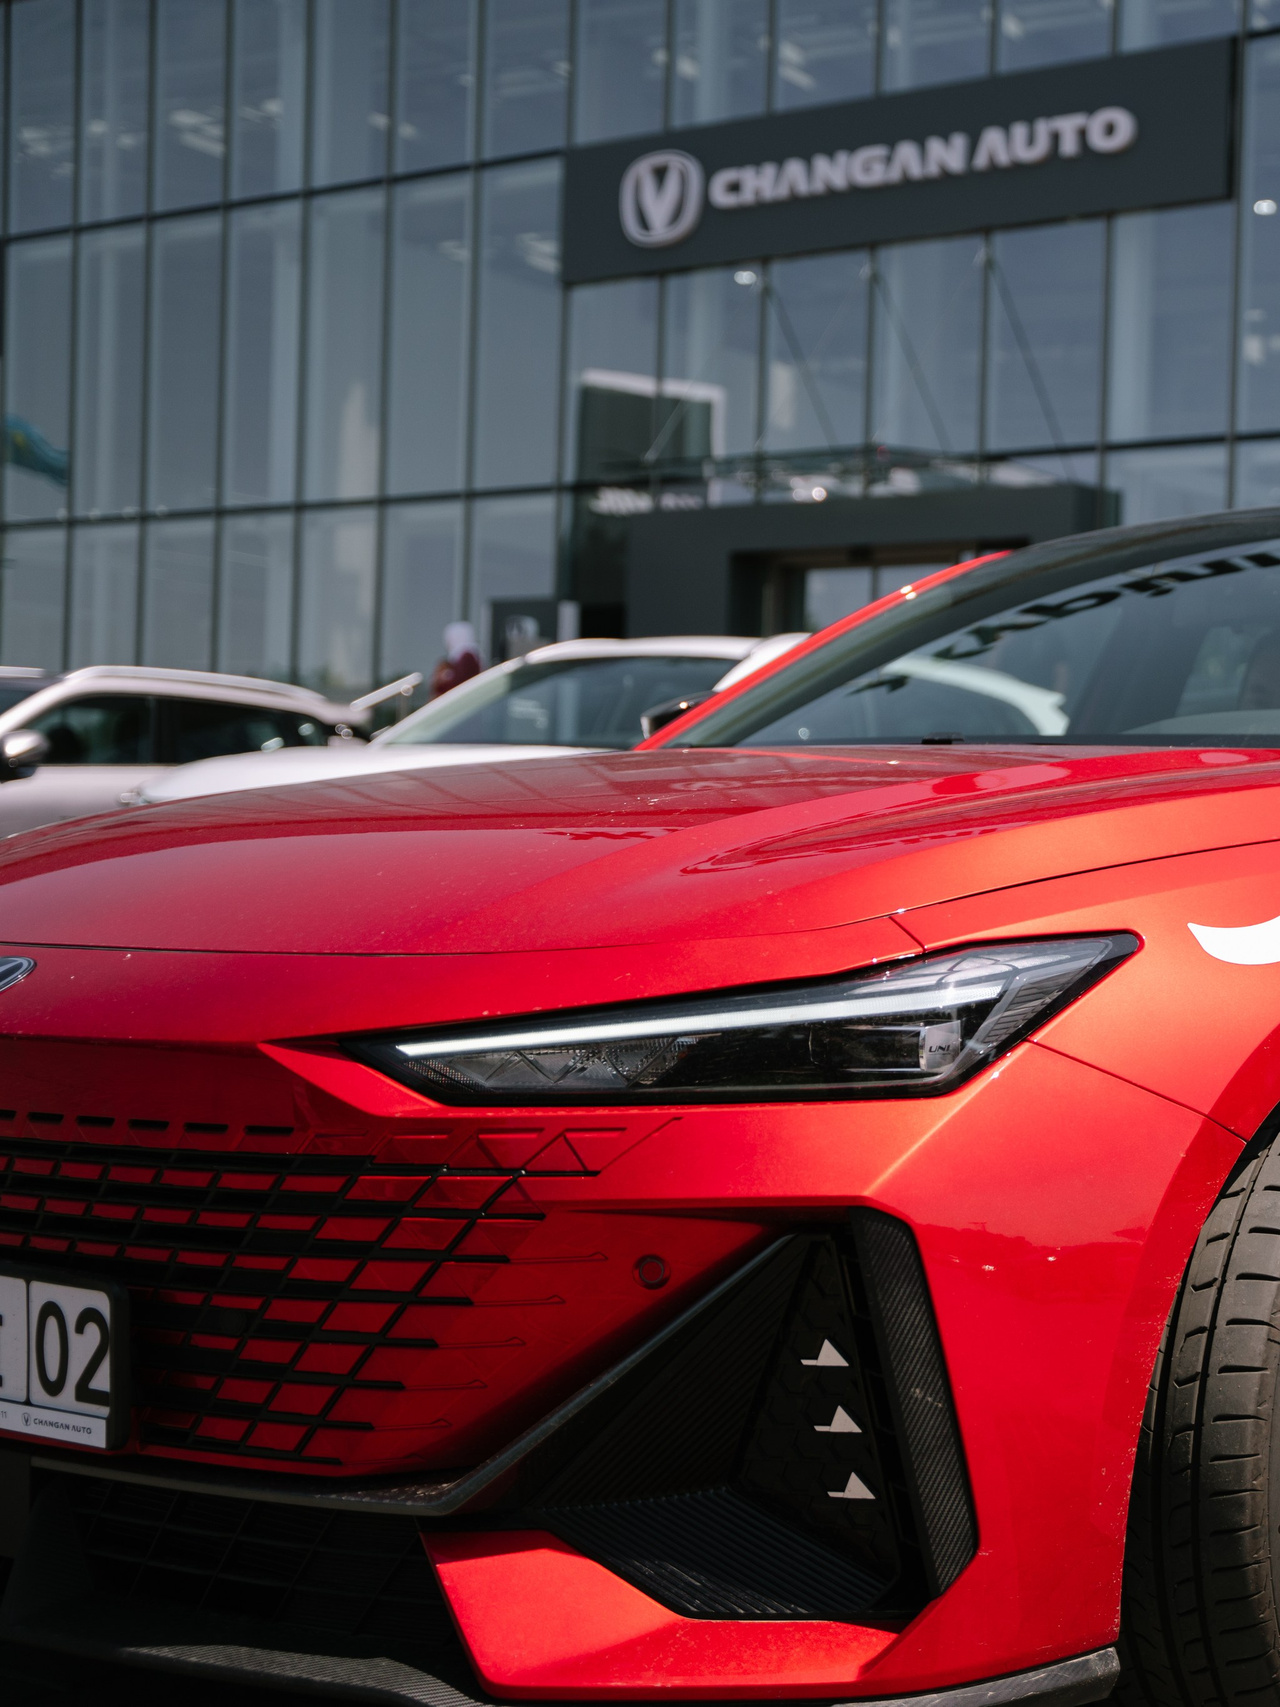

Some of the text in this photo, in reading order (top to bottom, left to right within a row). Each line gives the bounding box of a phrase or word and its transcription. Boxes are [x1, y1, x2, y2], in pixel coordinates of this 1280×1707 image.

[708, 106, 1136, 210] CHANGAN AUTO
[928, 1044, 951, 1053] UNI
[35, 1300, 109, 1407] 02
[33, 1417, 70, 1431] CHANGAN
[71, 1425, 93, 1435] AUTO
